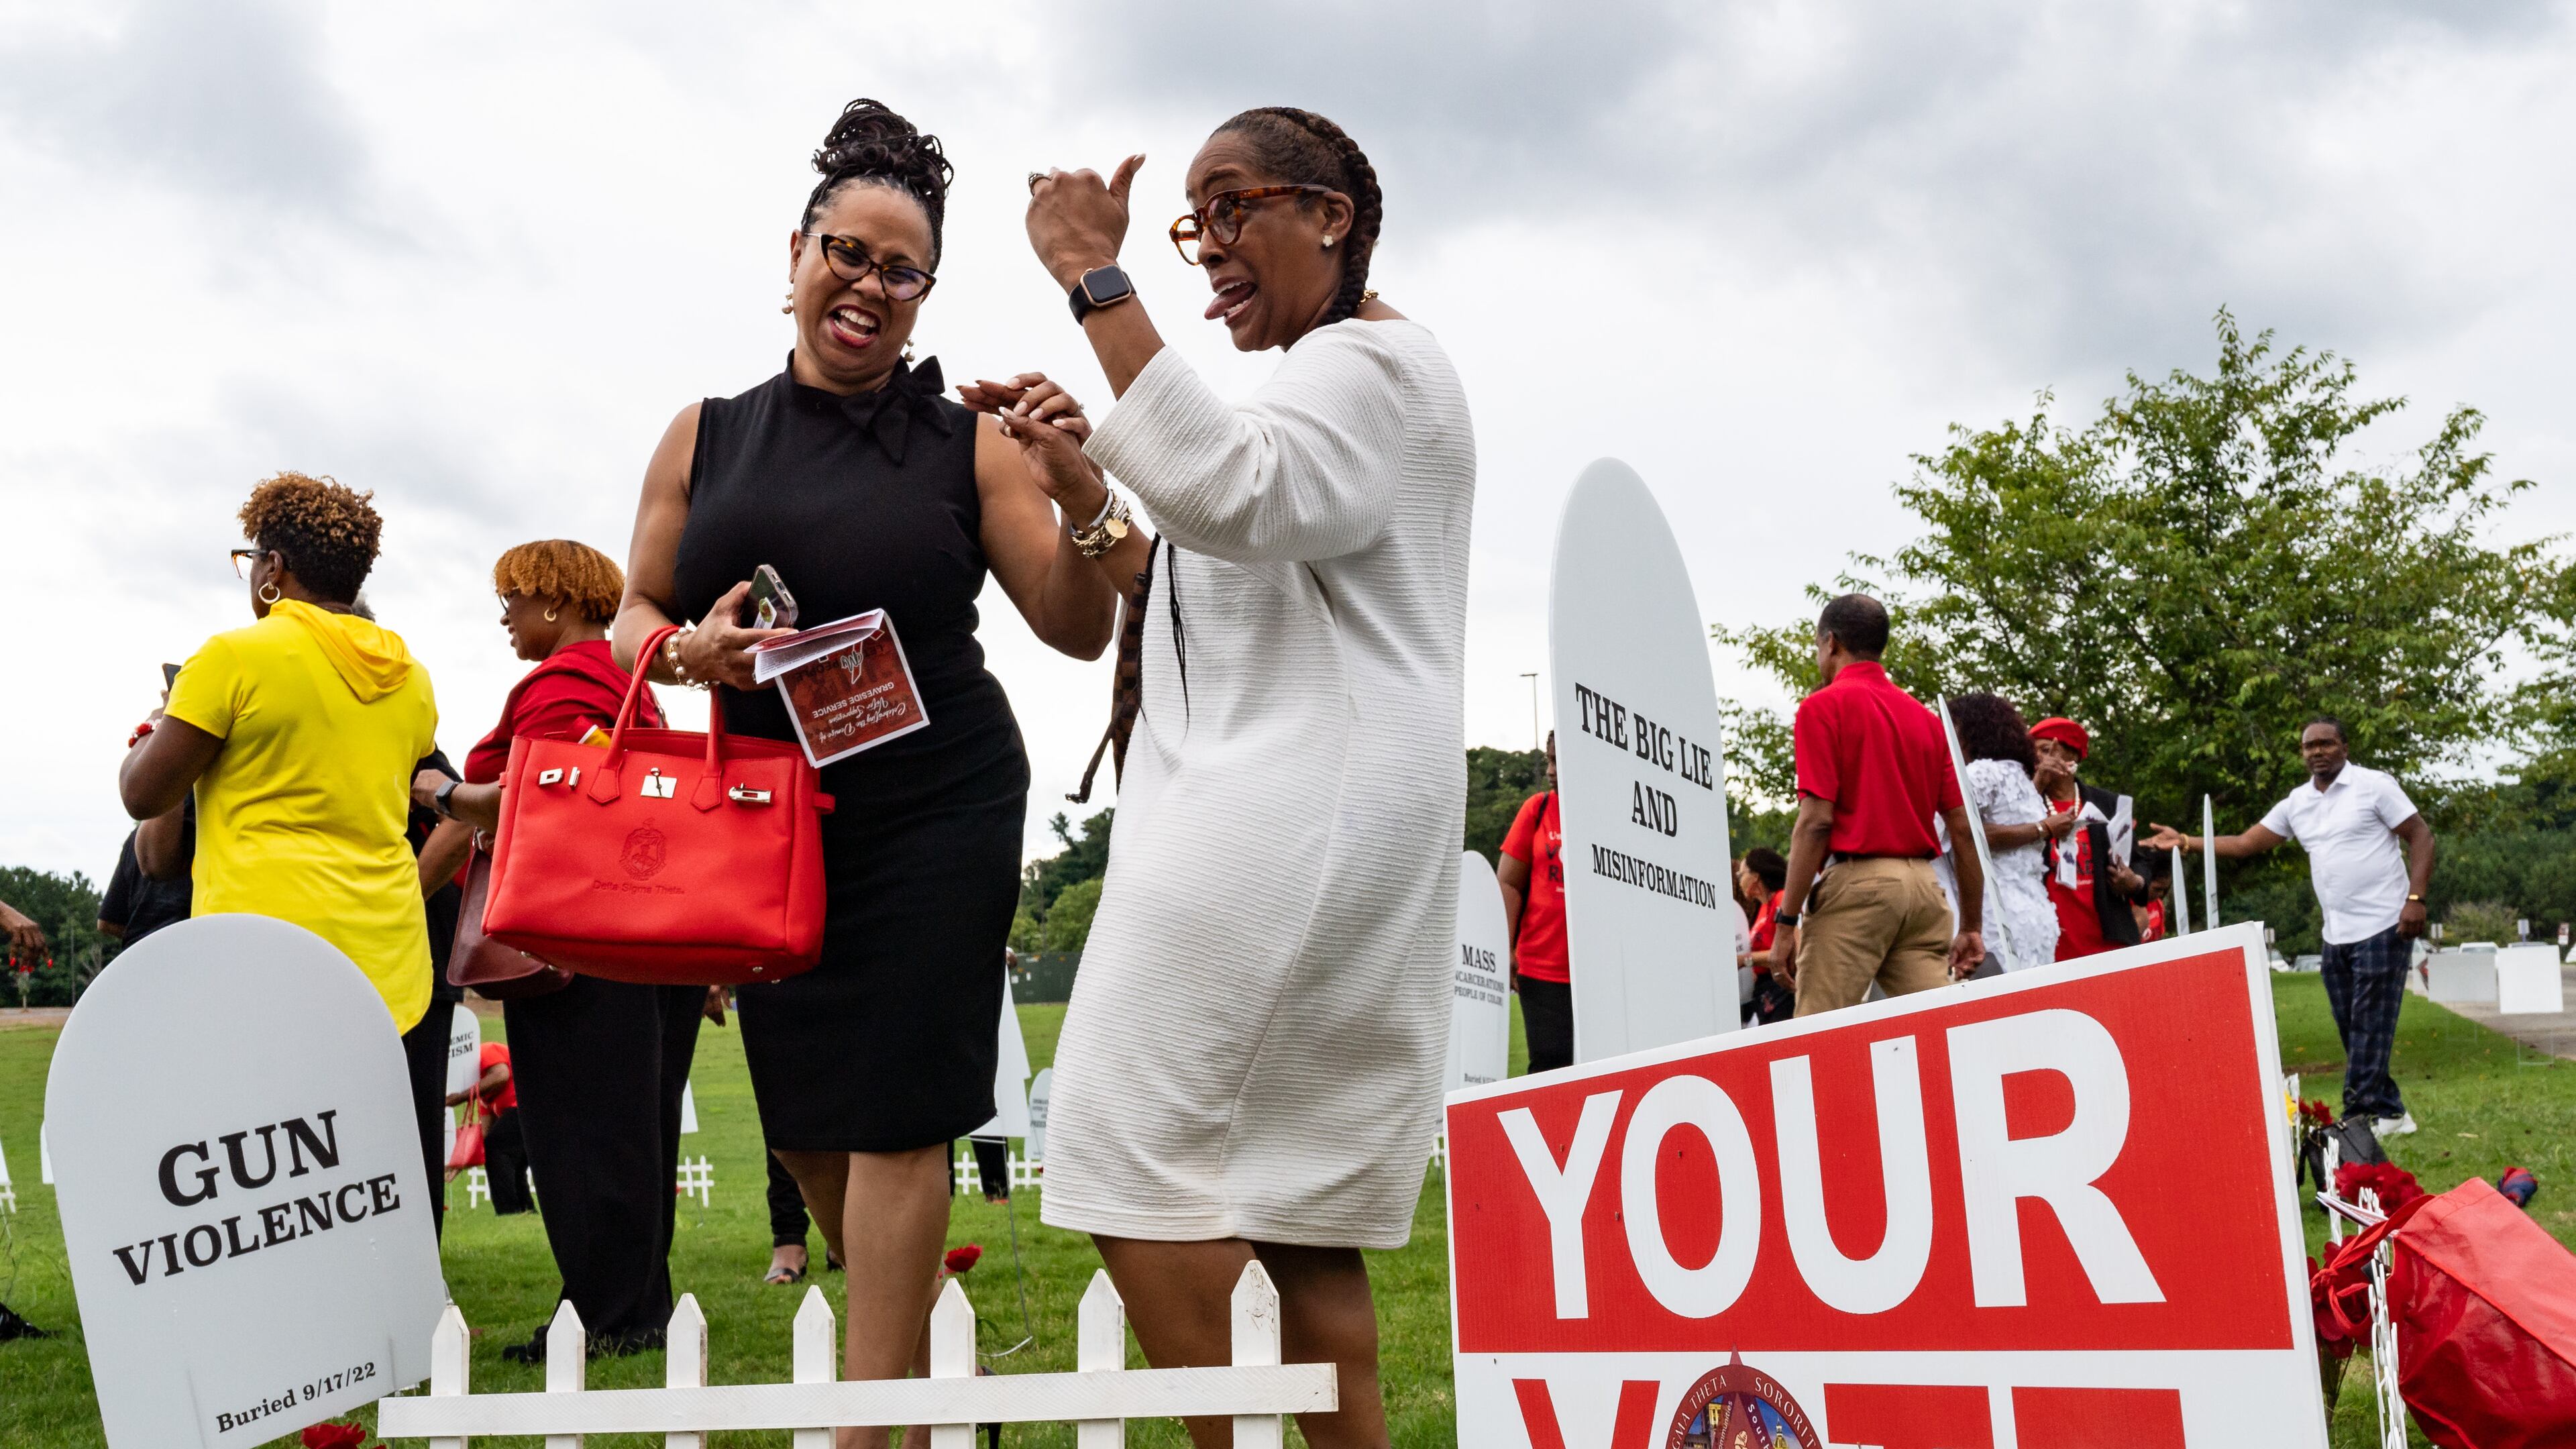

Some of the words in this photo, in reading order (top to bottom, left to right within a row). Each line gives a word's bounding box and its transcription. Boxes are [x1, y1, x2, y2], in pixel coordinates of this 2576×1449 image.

[849, 681, 895, 704] GRAVESIDE
[812, 699, 848, 718] SERVICE
[863, 697, 889, 715] Voter
[866, 702, 906, 725] Celebrating
[830, 723, 856, 737] Demise
[856, 719, 867, 729] the
[818, 732, 829, 743] of
[1575, 682, 1628, 751] THE
[1633, 712, 1674, 773] BIG
[1678, 736, 1713, 791] LIE
[1631, 780, 1677, 837] AND
[593, 879, 619, 891] Delta
[621, 883, 652, 895] Sigma
[1591, 843, 1716, 910] MISINFORMATION
[1462, 944, 1497, 973] MASS
[1454, 985, 1478, 1000] PEOPLE
[1455, 970, 1505, 994] NCARCERATIONS
[450, 1030, 474, 1045] EMIC
[449, 1042, 473, 1058] ISM
[159, 1109, 340, 1207] GUN
[1497, 1009, 2167, 1319] YOUR
[113, 1173, 400, 1286] VIOLENCE
[217, 1389, 297, 1434] Buried
[303, 1362, 376, 1401] 9/17/22
[1671, 1411, 1690, 1449] GMA
[1689, 1375, 1727, 1409] THETA
[1754, 1377, 1817, 1448] SORORIT
[1718, 1400, 1733, 1449] ommunities
